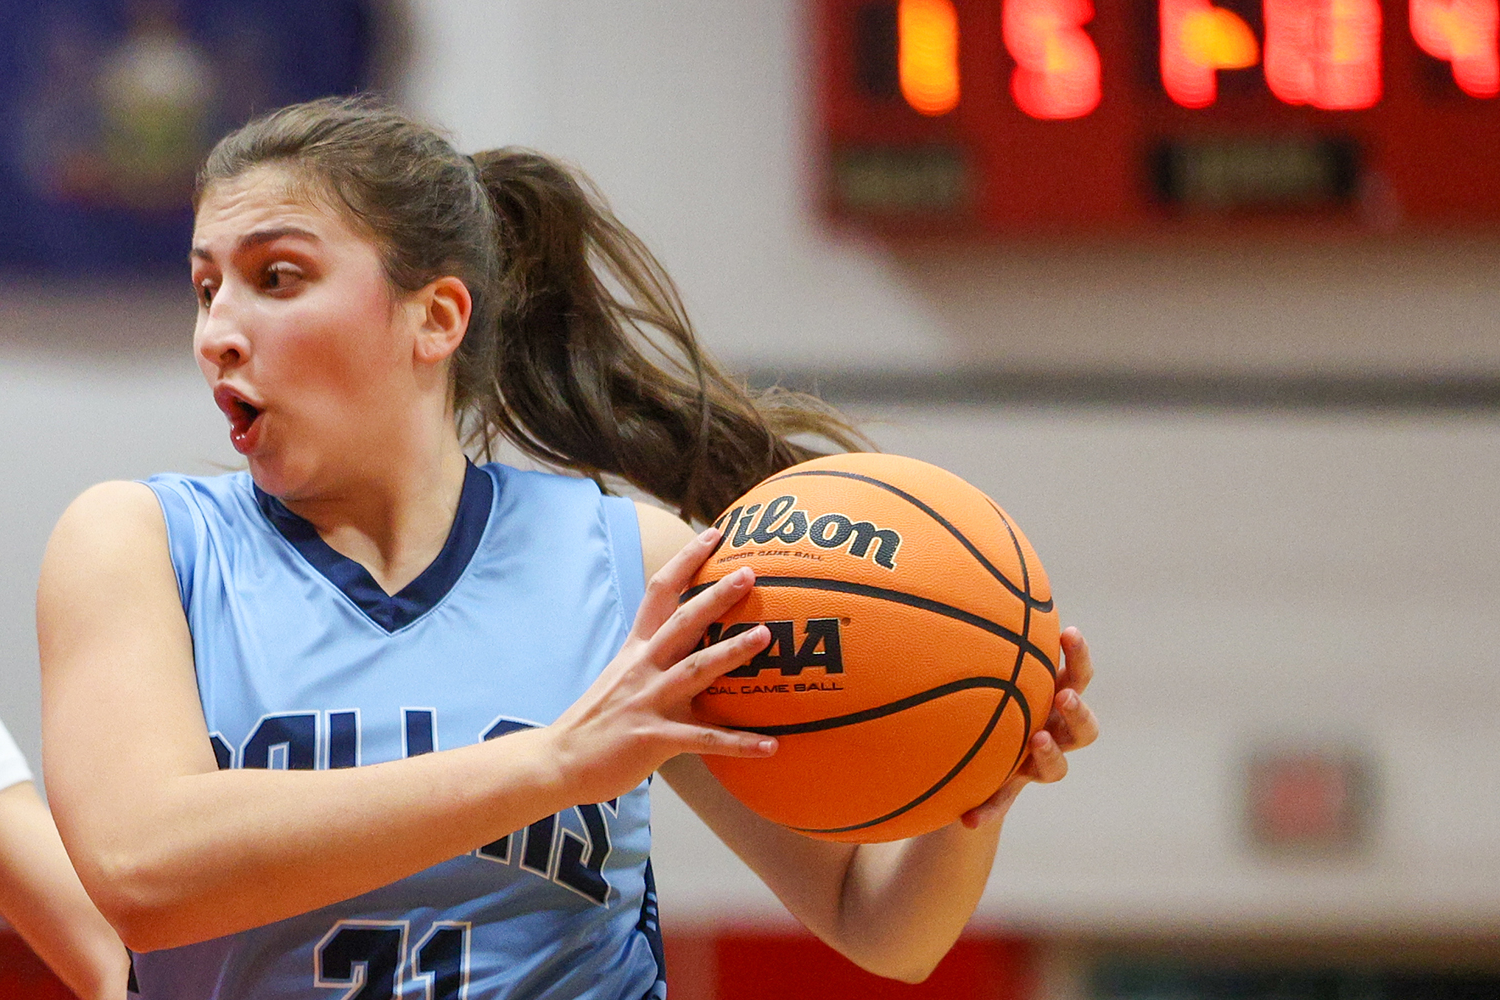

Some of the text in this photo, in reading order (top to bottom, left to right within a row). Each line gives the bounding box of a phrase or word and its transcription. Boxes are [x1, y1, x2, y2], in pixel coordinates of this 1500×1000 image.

[757, 550, 790, 558] GAME
[794, 550, 824, 562] BALL
[697, 617, 845, 678] CAA
[706, 682, 845, 695] CIAL GAME BALL
